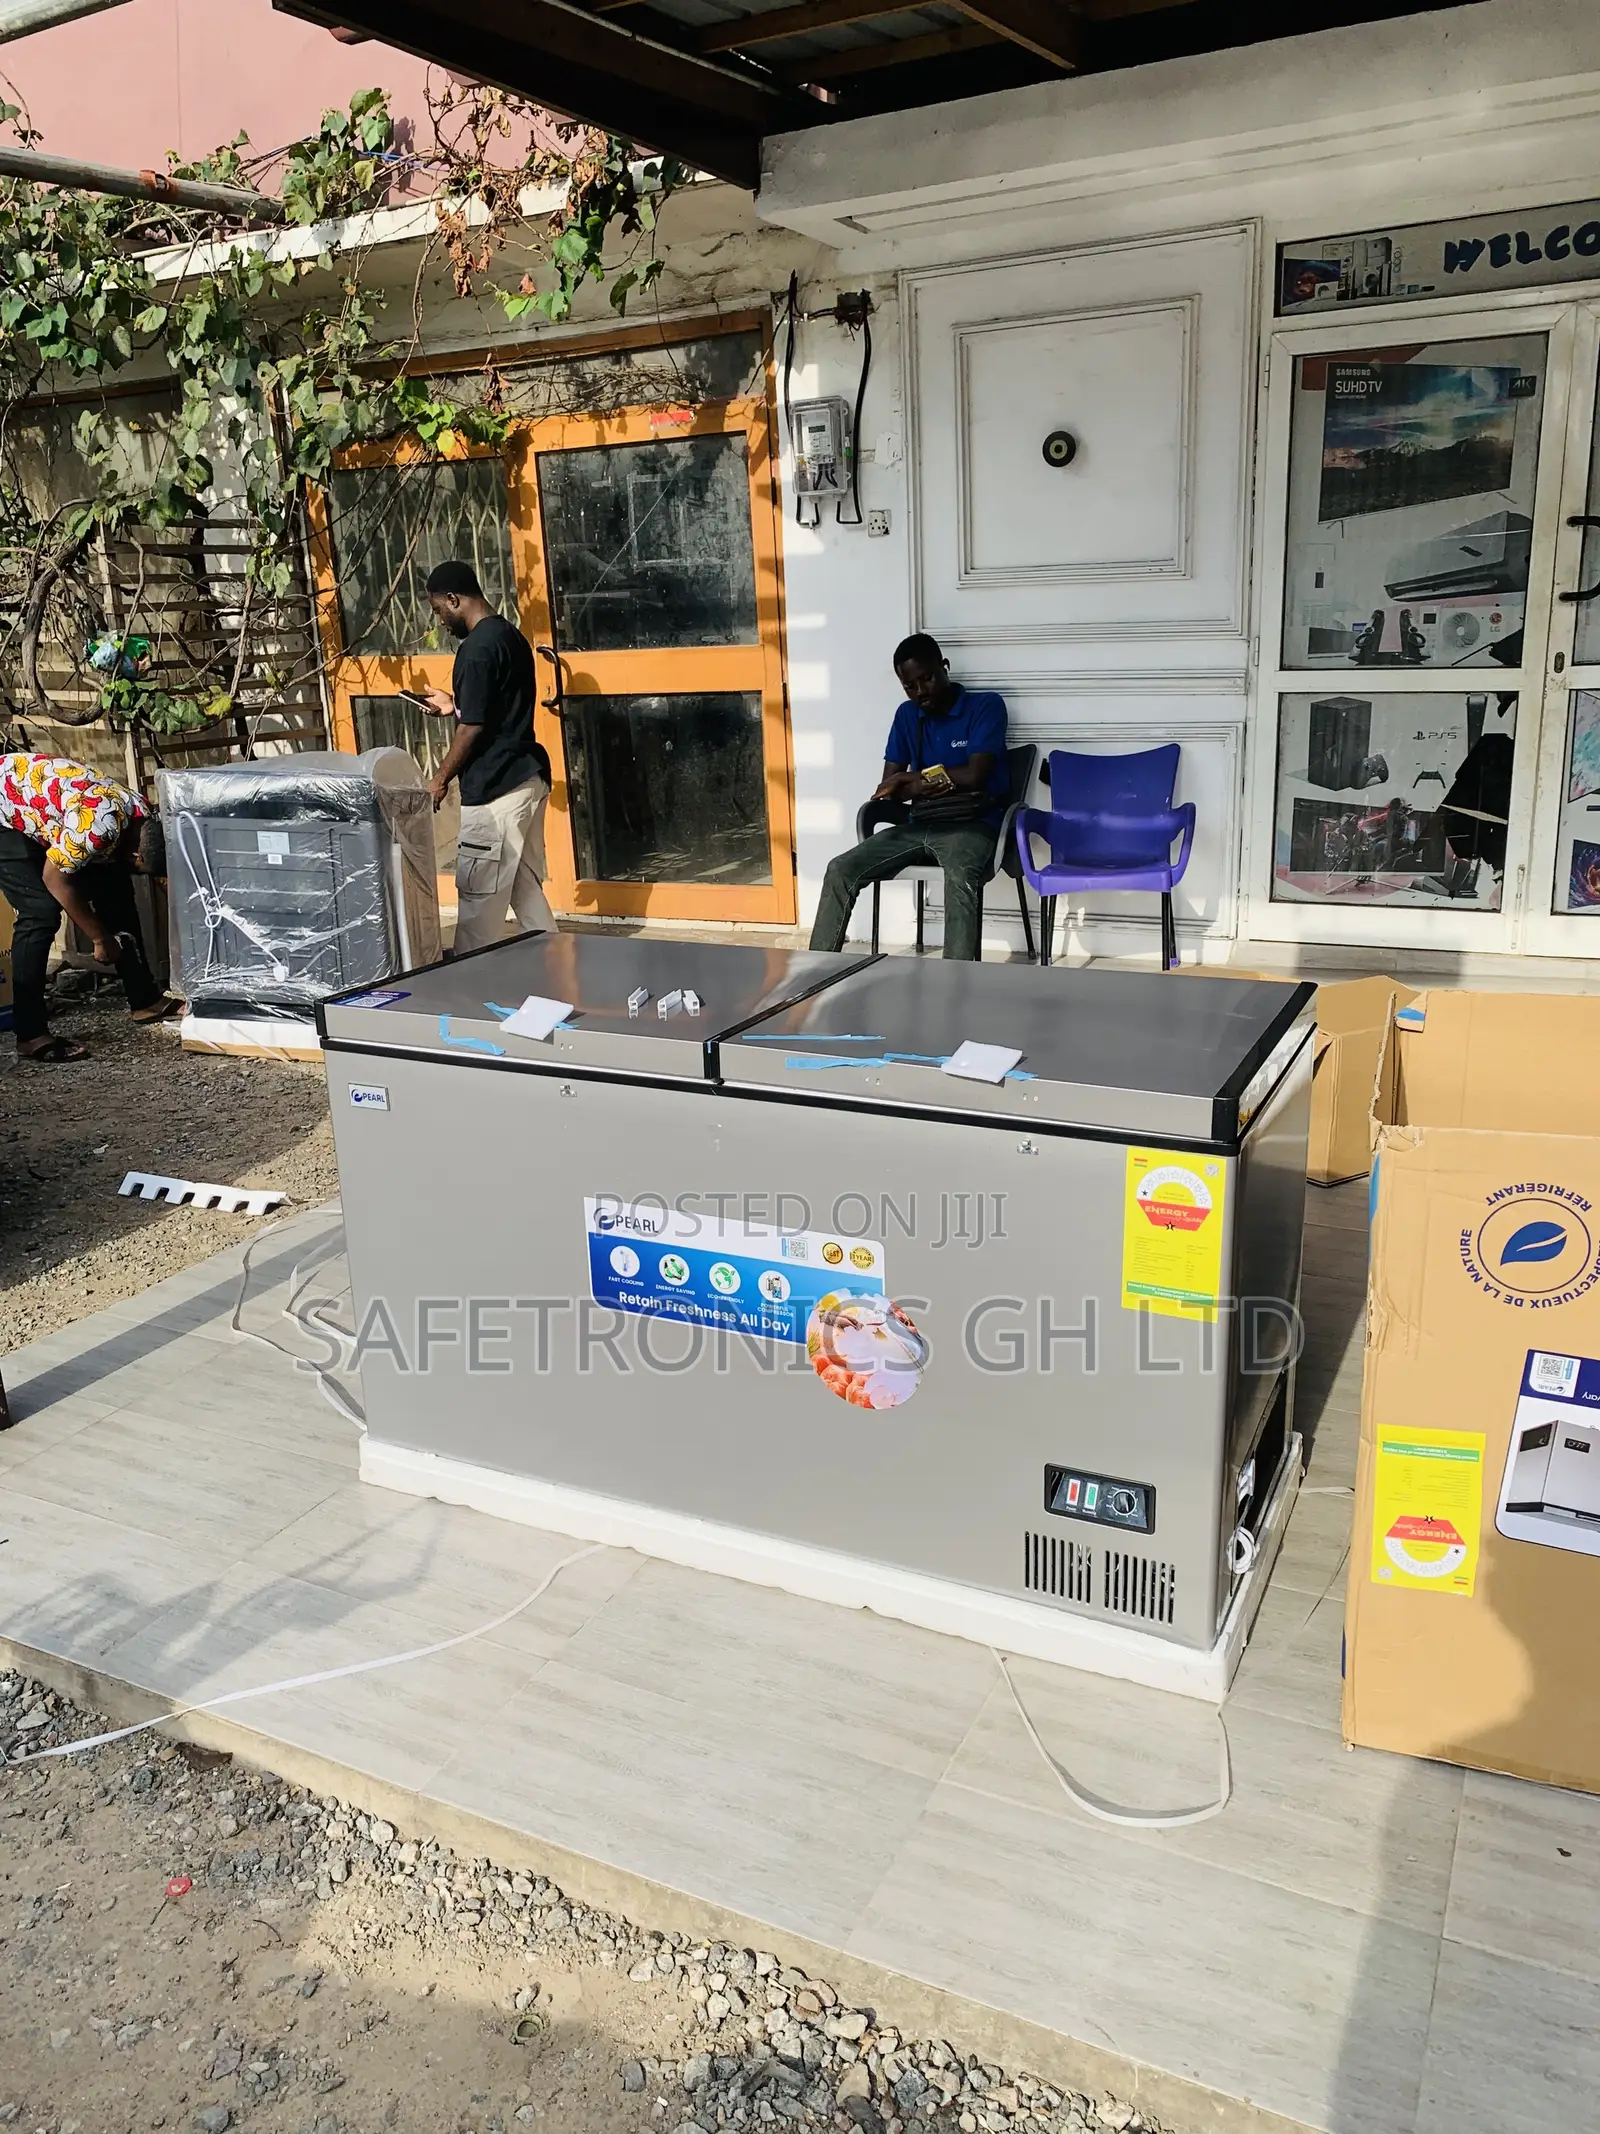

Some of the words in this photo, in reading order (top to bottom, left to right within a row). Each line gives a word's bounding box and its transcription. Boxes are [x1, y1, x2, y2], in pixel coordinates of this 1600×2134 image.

[1443, 221, 1600, 275] WELCO
[1336, 368, 1371, 377] SAMSUNG
[1428, 731, 1457, 740] PS5
[362, 1092, 386, 1103] PEARL
[1485, 1182, 1592, 1212] RÉFRIGÉRANT
[1144, 1205, 1190, 1218] ENERGY
[615, 1214, 660, 1234] PEARL
[1459, 1228, 1483, 1283] NATURE
[1529, 1240, 1600, 1309] PECTUEUX
[1483, 1282, 1501, 1299] LA
[1503, 1294, 1525, 1308] DE
[618, 1291, 663, 1310] Retain
[665, 1299, 737, 1323] Freshness
[740, 1313, 758, 1327] All
[761, 1316, 791, 1336] Day
[1409, 1528, 1458, 1540] ENERGY
